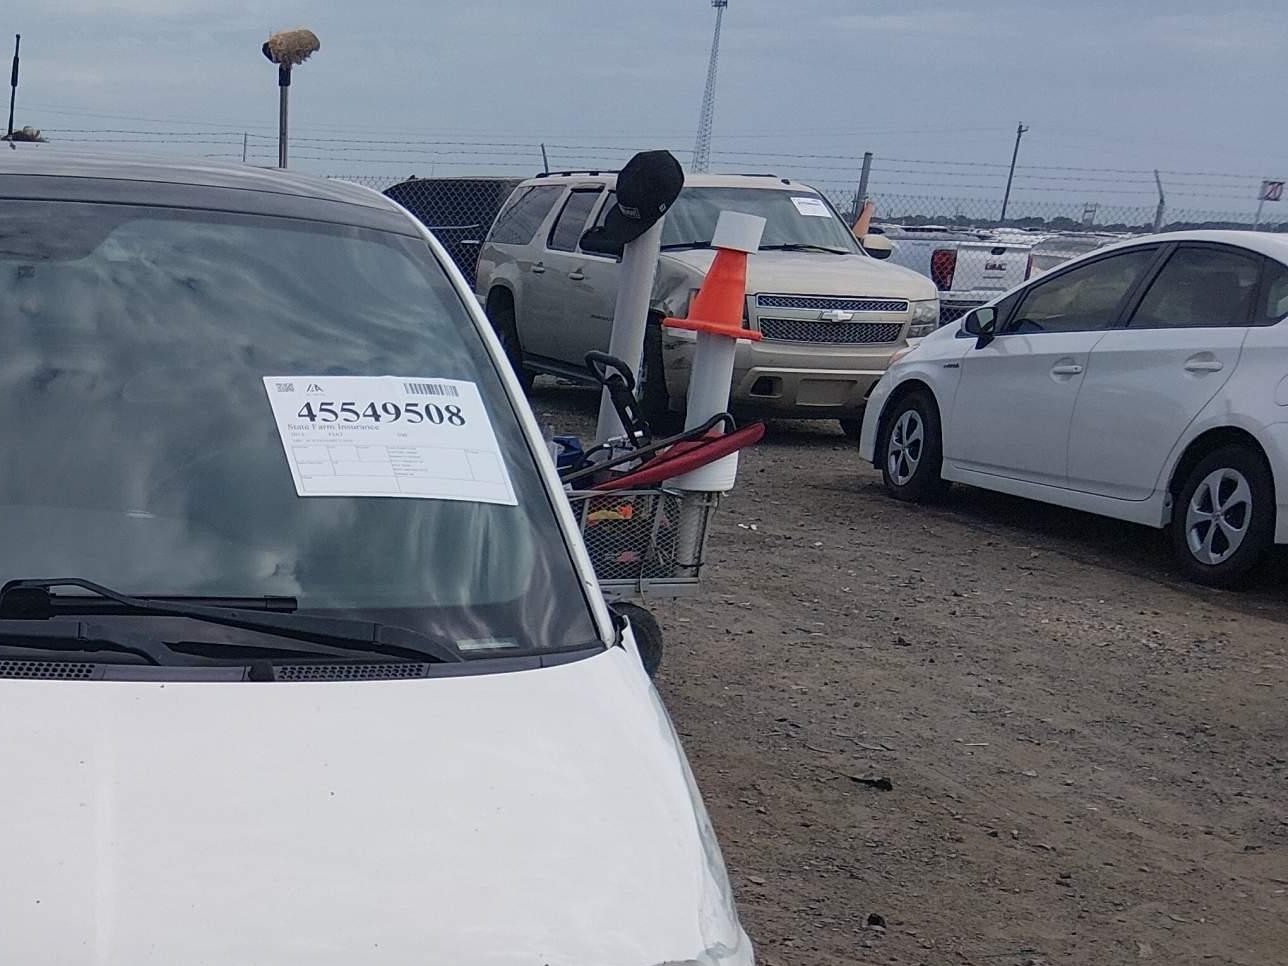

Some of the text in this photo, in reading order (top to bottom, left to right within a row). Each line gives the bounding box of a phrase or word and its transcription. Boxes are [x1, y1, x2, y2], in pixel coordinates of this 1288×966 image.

[298, 402, 466, 426] 45549508
[288, 423, 310, 431] State
[312, 423, 335, 431] Farm
